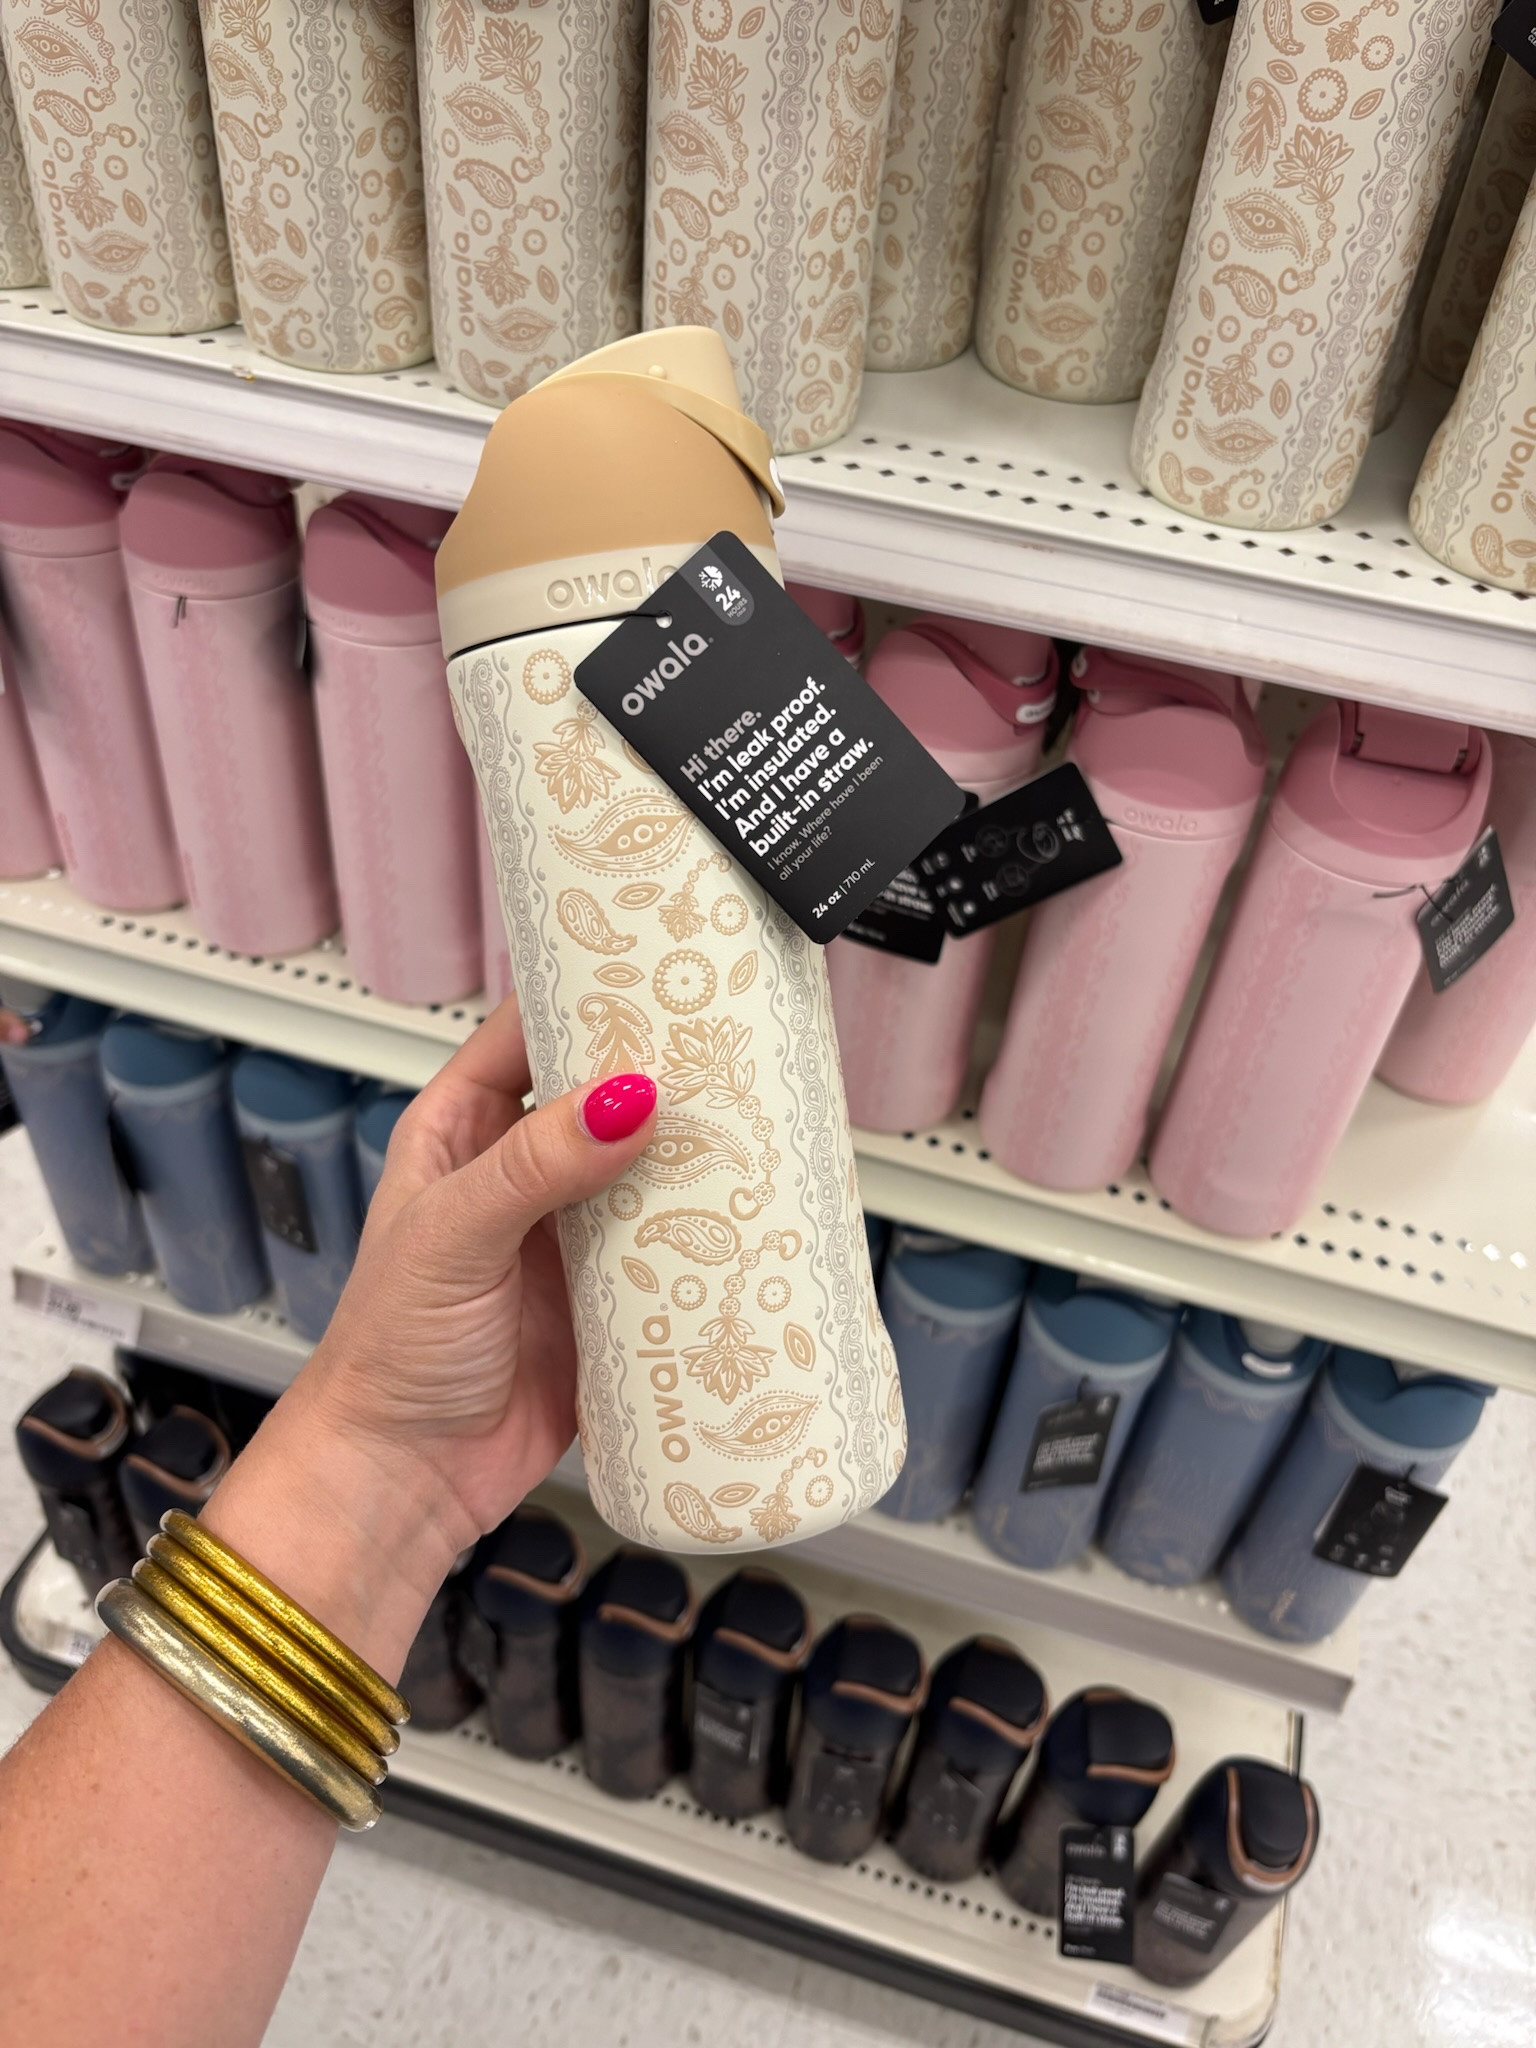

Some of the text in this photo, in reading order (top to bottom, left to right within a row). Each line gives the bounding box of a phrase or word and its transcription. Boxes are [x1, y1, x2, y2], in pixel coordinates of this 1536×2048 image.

[450, 231, 476, 337] owala
[1004, 228, 1033, 325] owala
[1171, 335, 1212, 441] owala
[715, 585, 741, 612] 24
[621, 632, 709, 716] owala
[680, 710, 762, 783] Hi there.
[698, 676, 826, 801] I'm leak proof.
[714, 702, 837, 821] I'm insulated.
[734, 727, 846, 840] And I have a
[748, 738, 874, 857] built-in straw.
[772, 838, 802, 868] know.
[798, 808, 833, 839] Where
[829, 785, 855, 810] have
[857, 755, 884, 782] been
[778, 825, 833, 882] all your life?
[811, 902, 829, 920] 24
[826, 890, 842, 906] oz
[842, 870, 861, 890] 710
[859, 857, 876, 875] mL
[636, 1315, 691, 1463] owala
